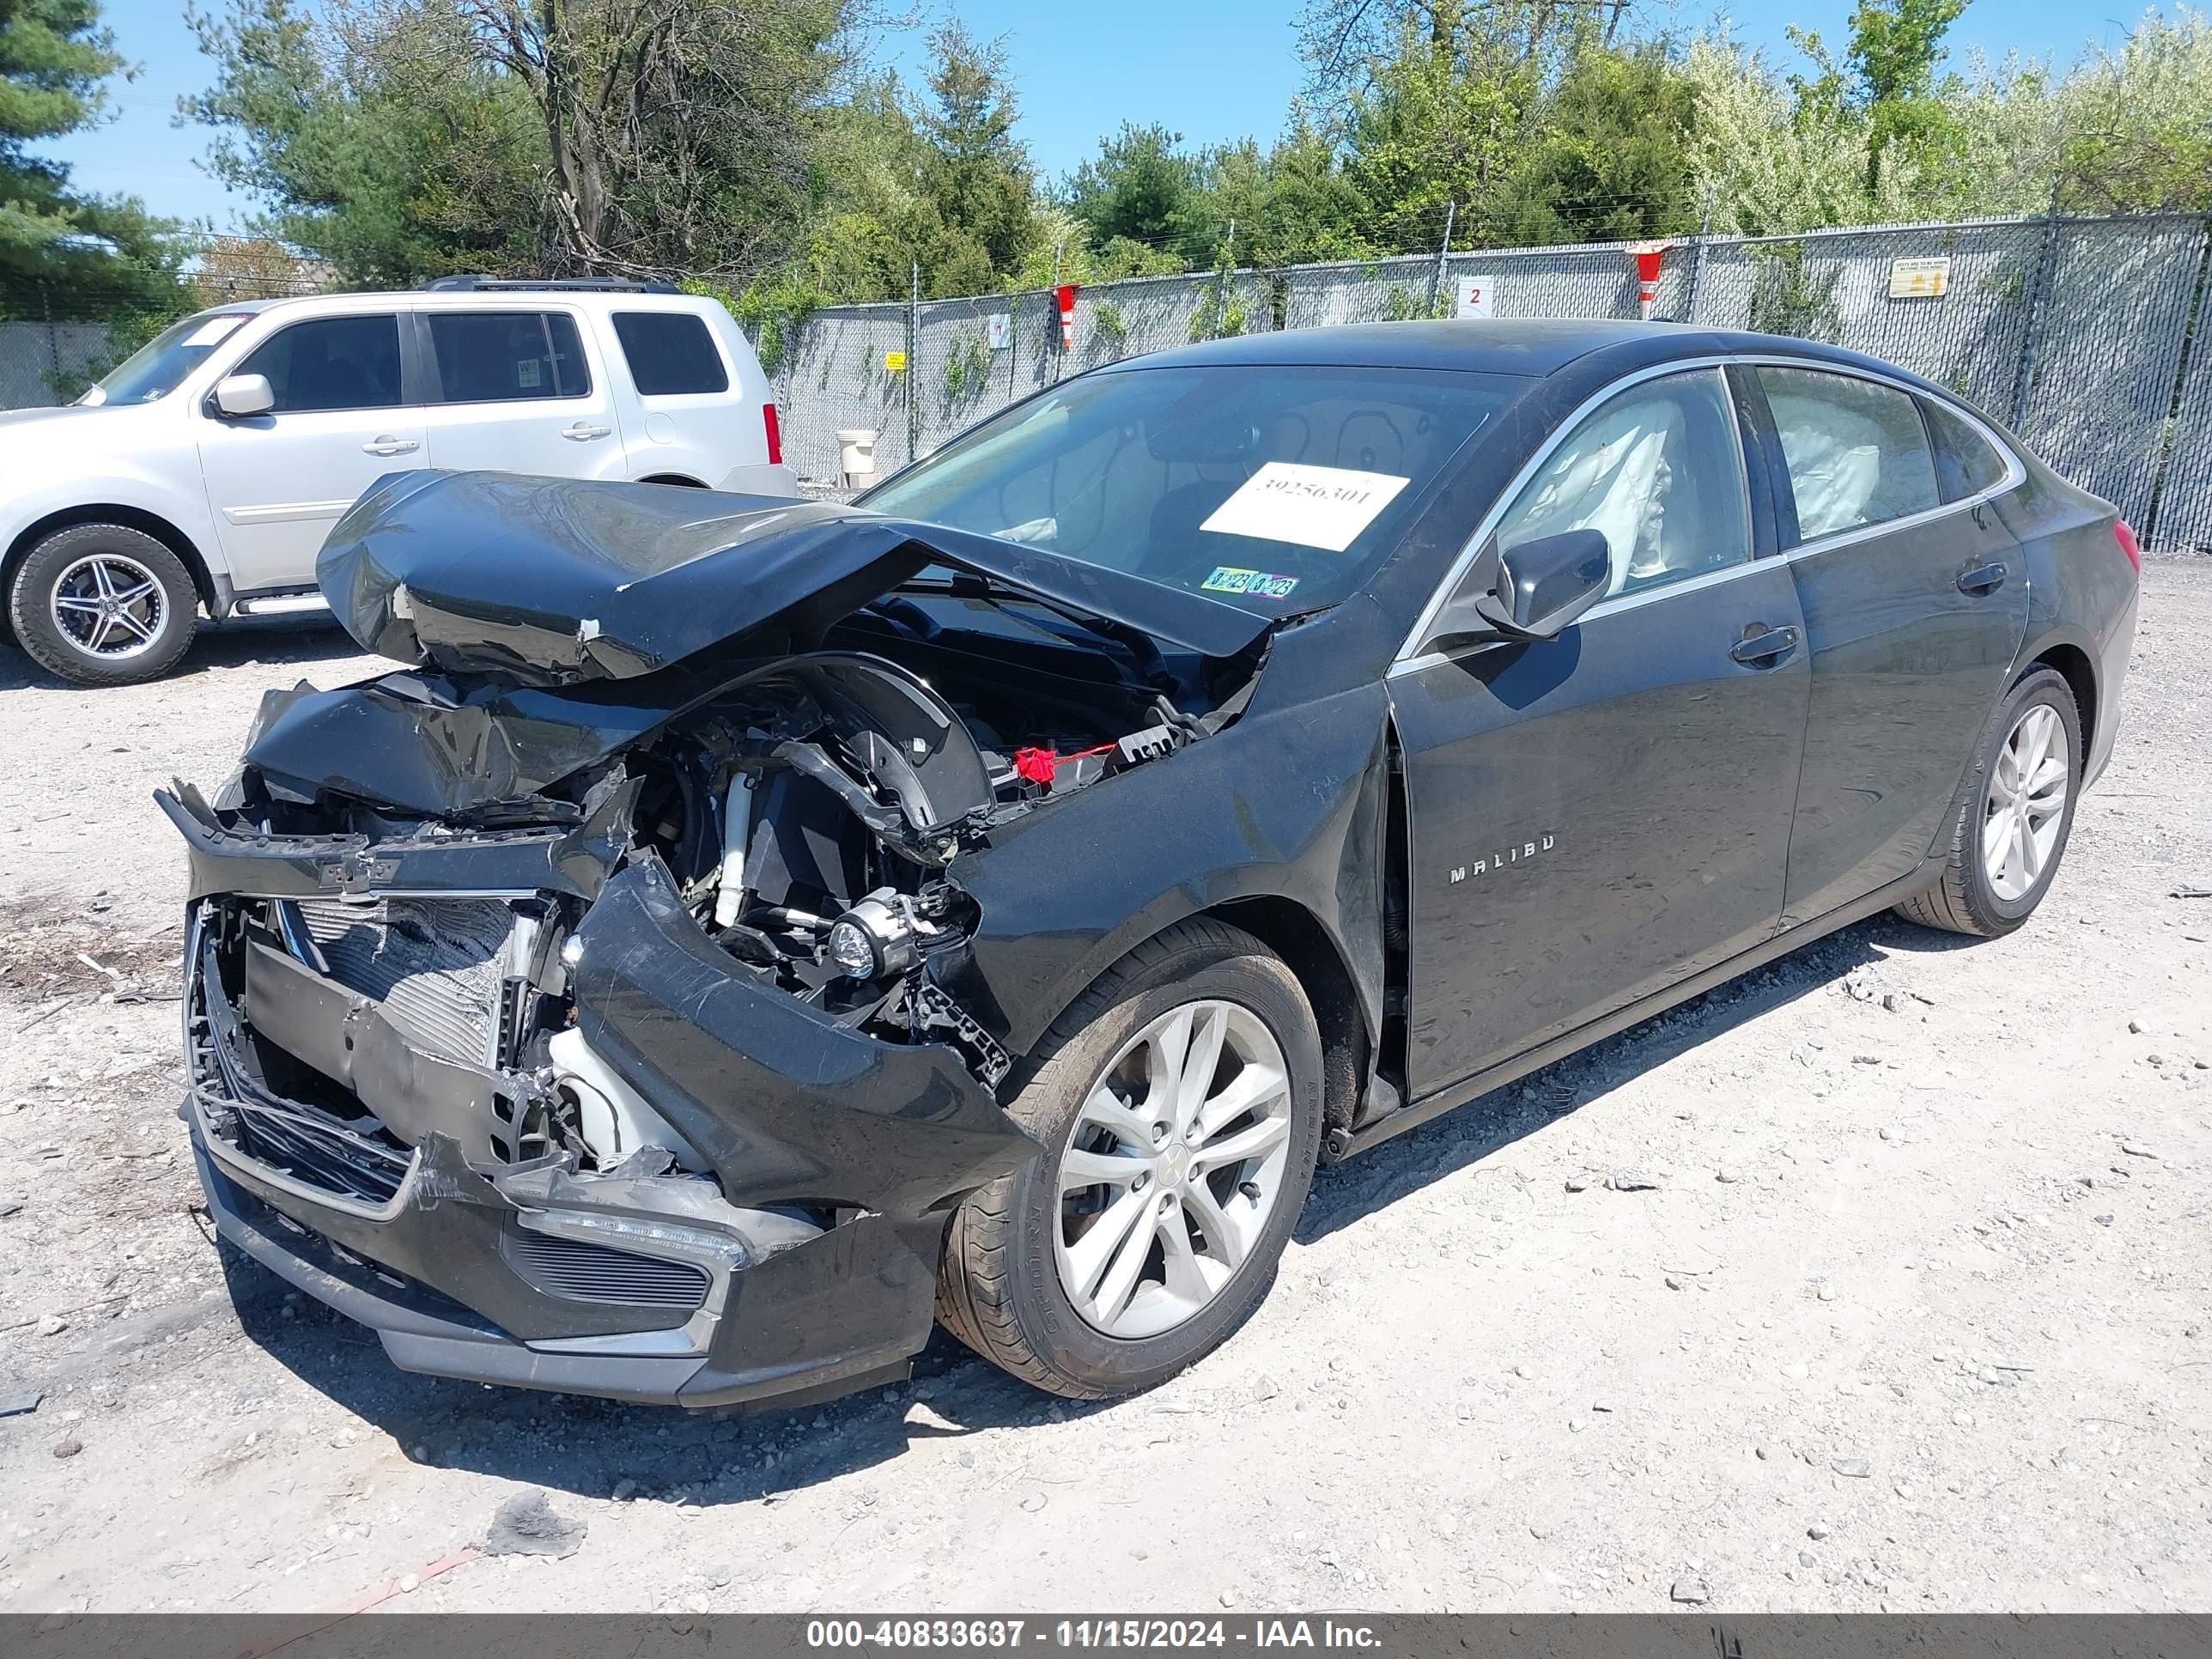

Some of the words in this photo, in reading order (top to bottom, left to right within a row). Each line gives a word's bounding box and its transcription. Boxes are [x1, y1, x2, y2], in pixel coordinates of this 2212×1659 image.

[1469, 289, 1481, 304] 2
[1255, 478, 1371, 505] 39256301
[1449, 836, 1554, 884] MALIBU
